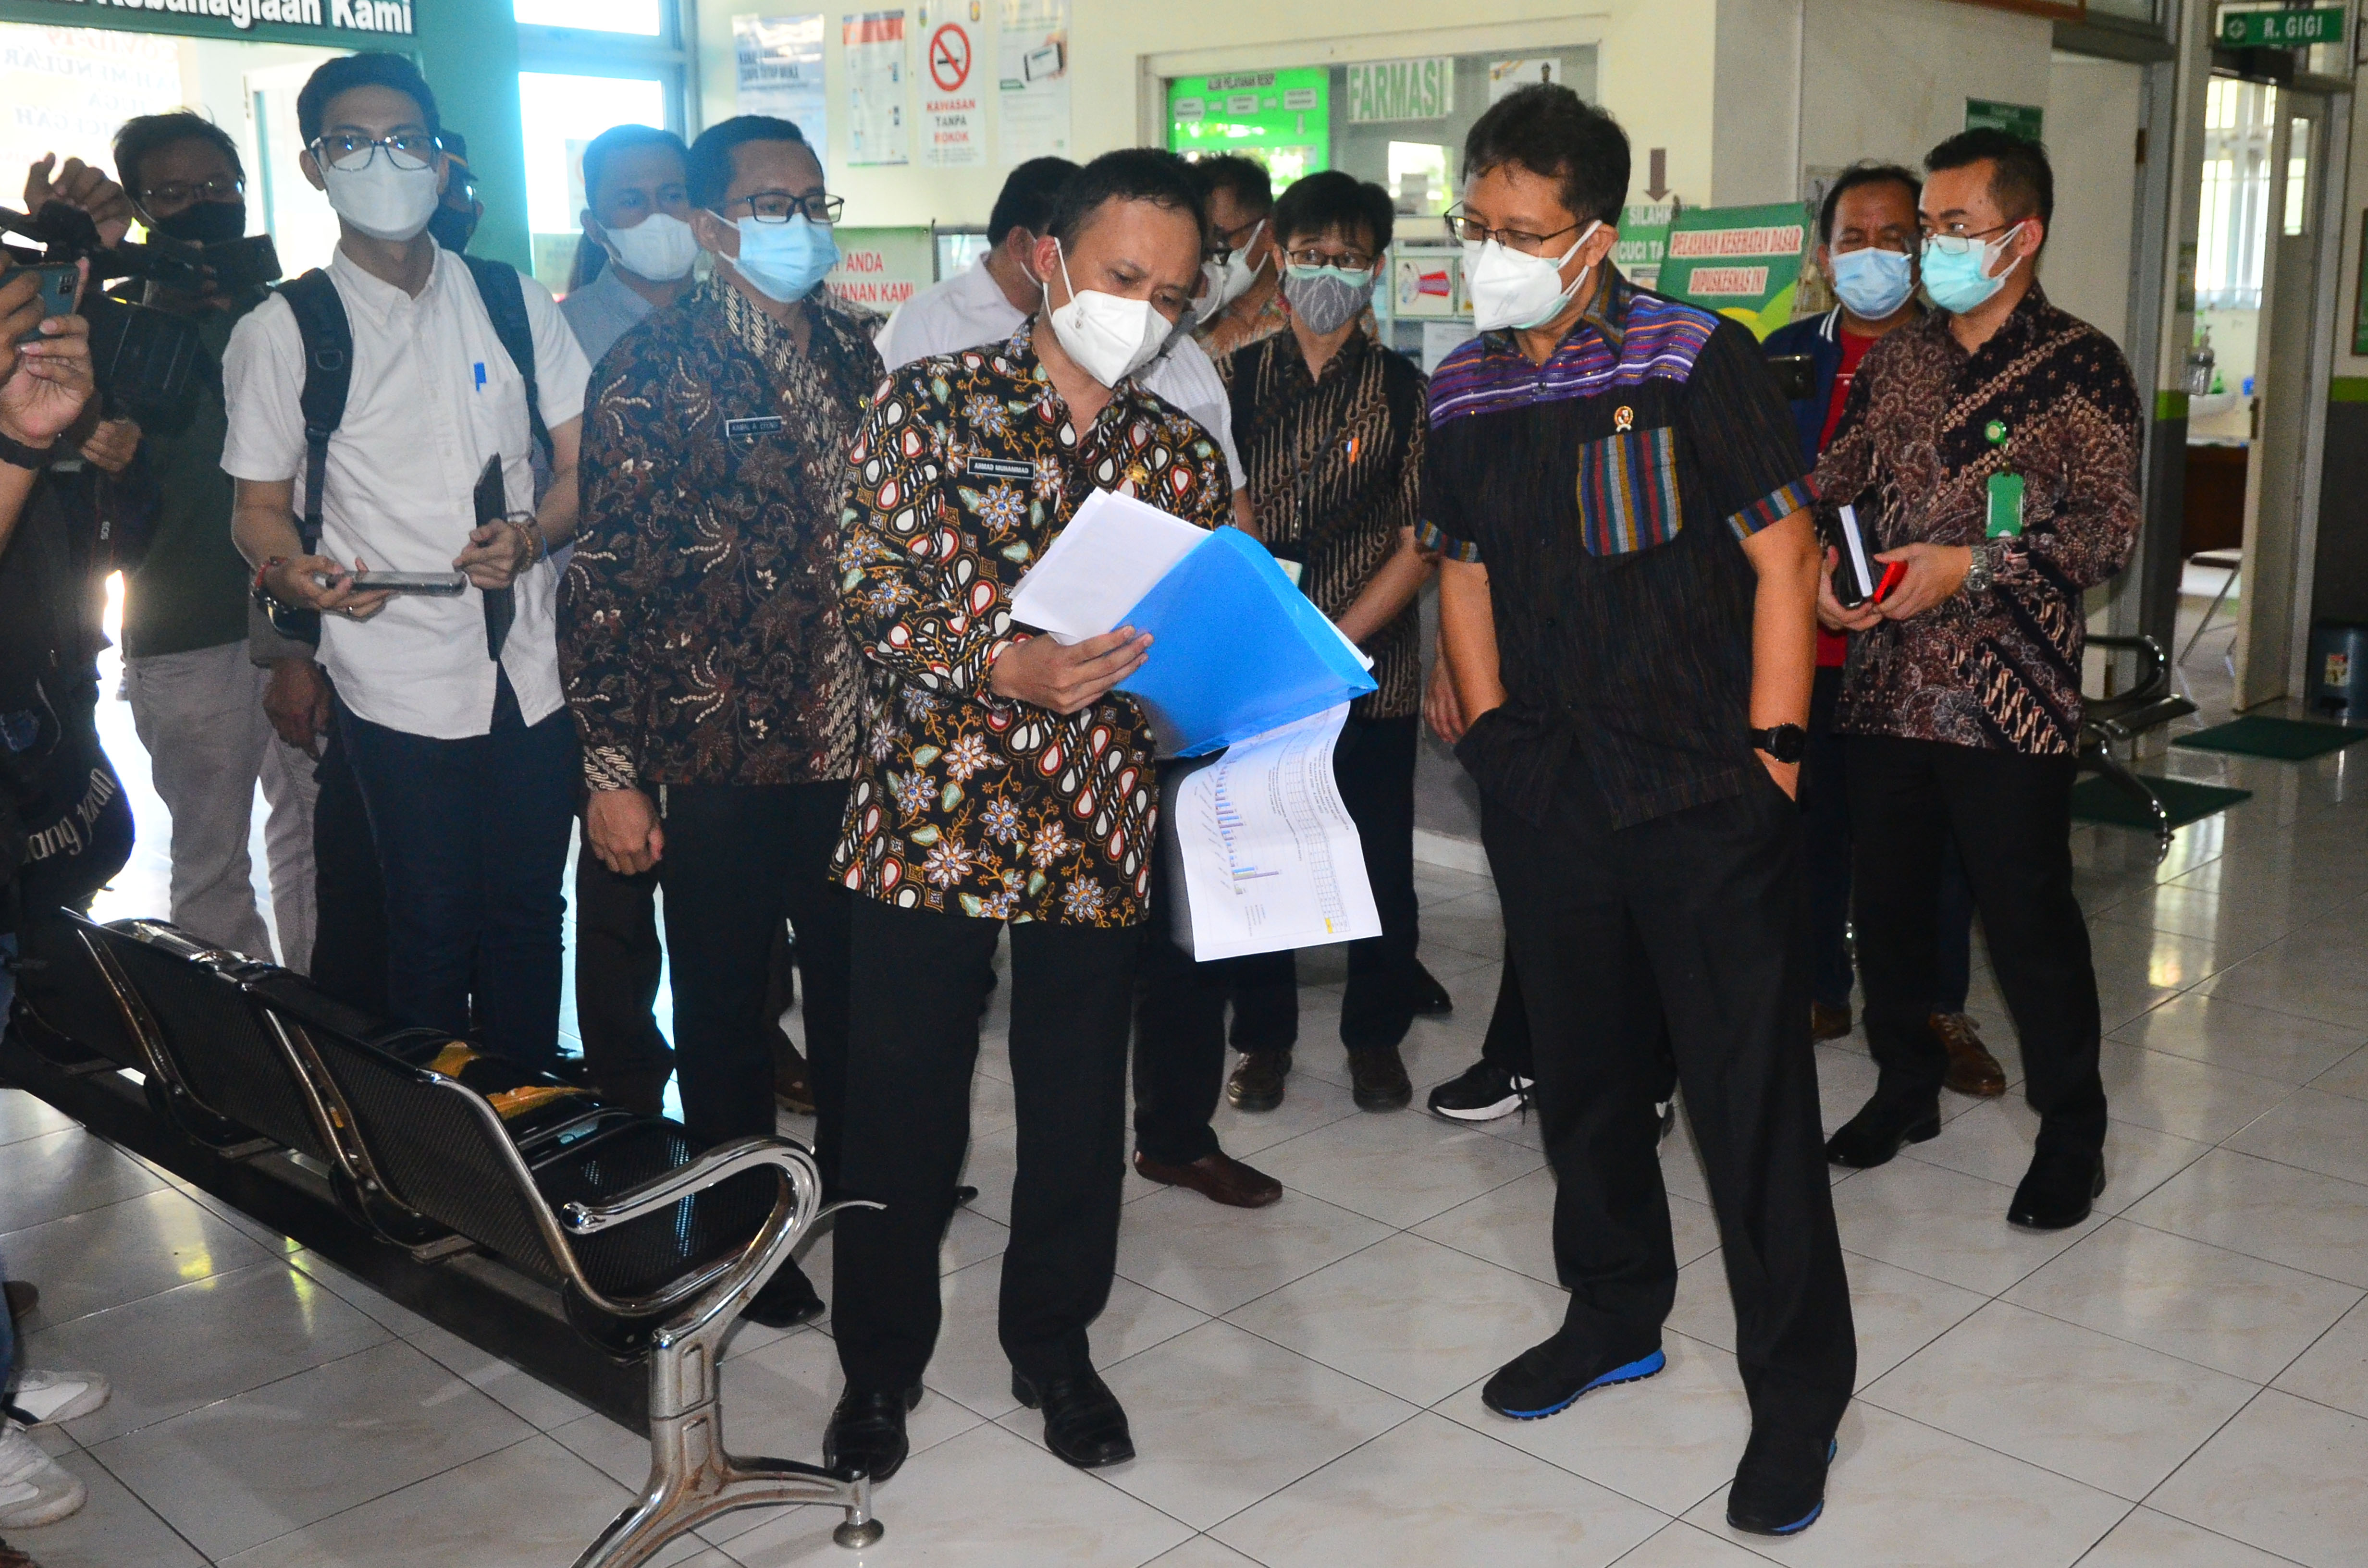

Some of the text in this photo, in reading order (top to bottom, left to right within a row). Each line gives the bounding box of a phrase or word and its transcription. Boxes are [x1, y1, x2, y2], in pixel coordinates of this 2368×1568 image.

[331, 0, 412, 34] Kami
[2263, 15, 2323, 38] R. GIGI
[1349, 59, 1444, 120] FARMASI
[935, 115, 967, 126] TANPA
[846, 252, 884, 271] ANDA
[881, 282, 913, 302] KAMI
[974, 462, 994, 471] AHMAD
